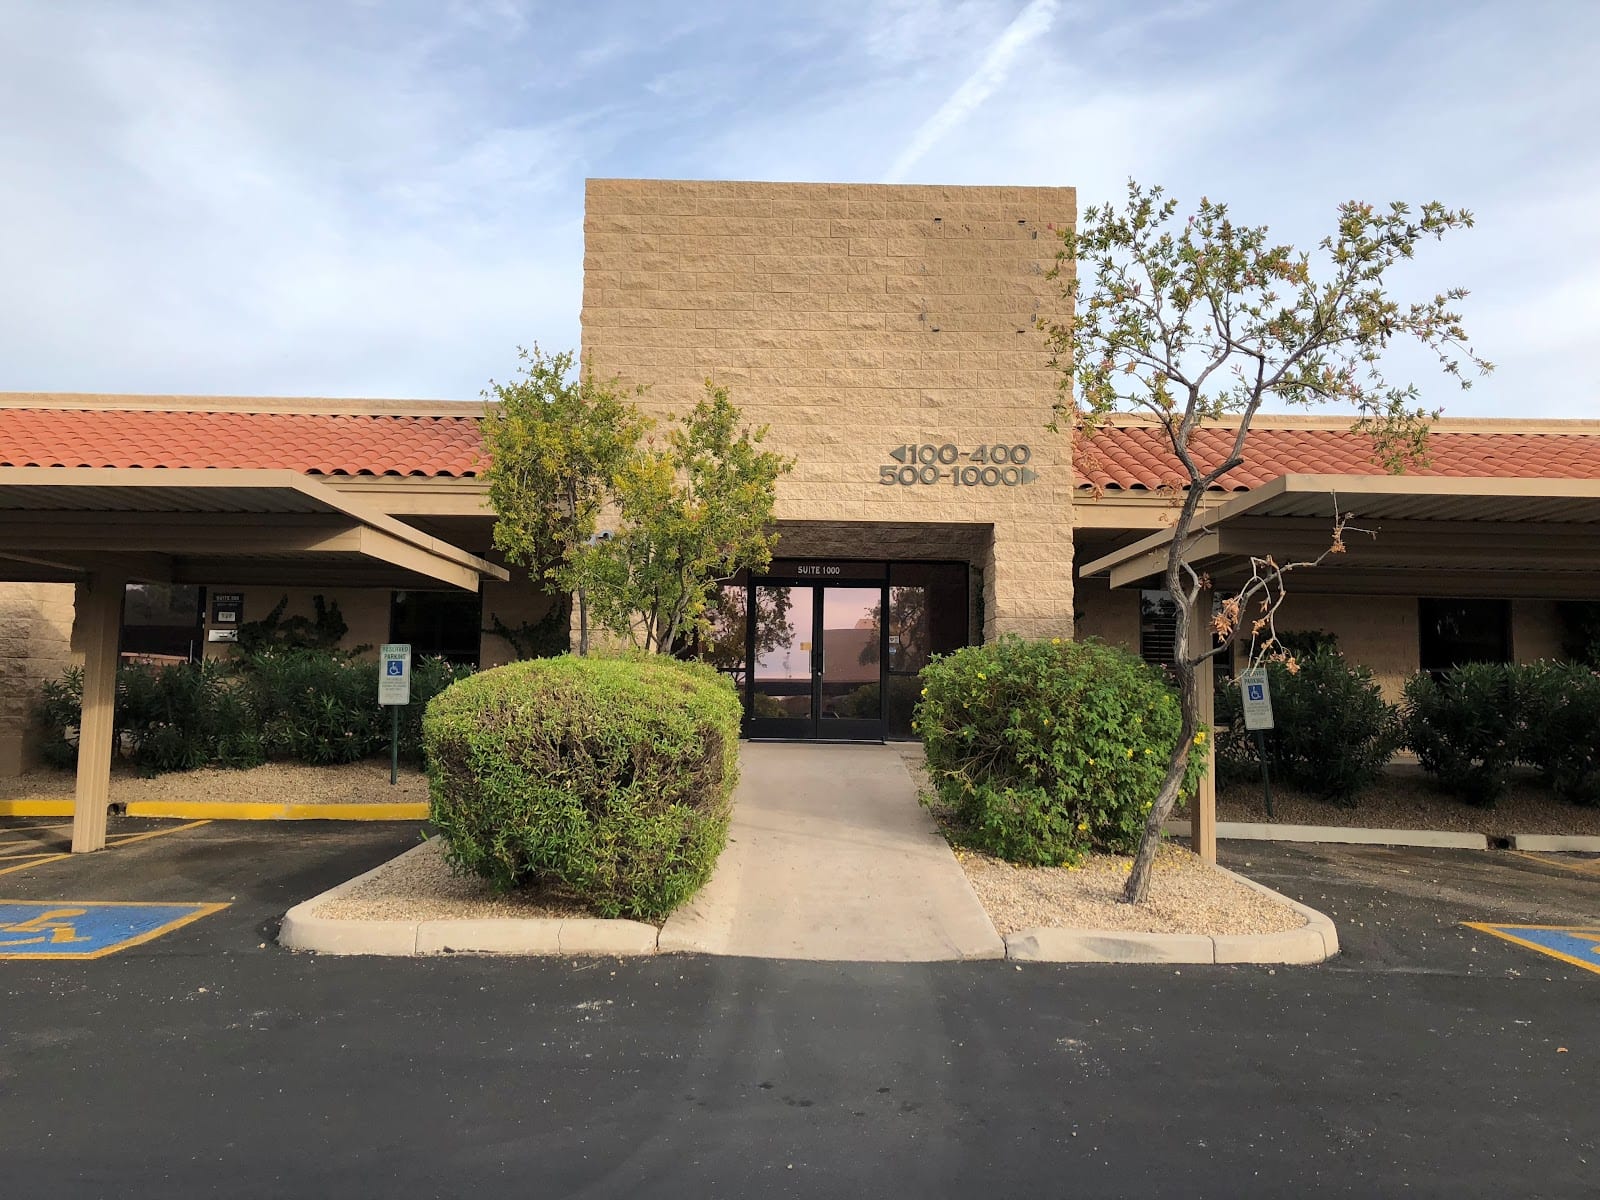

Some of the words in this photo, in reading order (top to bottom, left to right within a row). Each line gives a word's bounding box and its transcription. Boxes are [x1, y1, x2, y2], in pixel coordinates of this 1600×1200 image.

[907, 443, 1031, 465] 100-400
[879, 464, 1022, 486] 500-1000
[797, 565, 820, 575] SUITE
[822, 566, 841, 575] 1000
